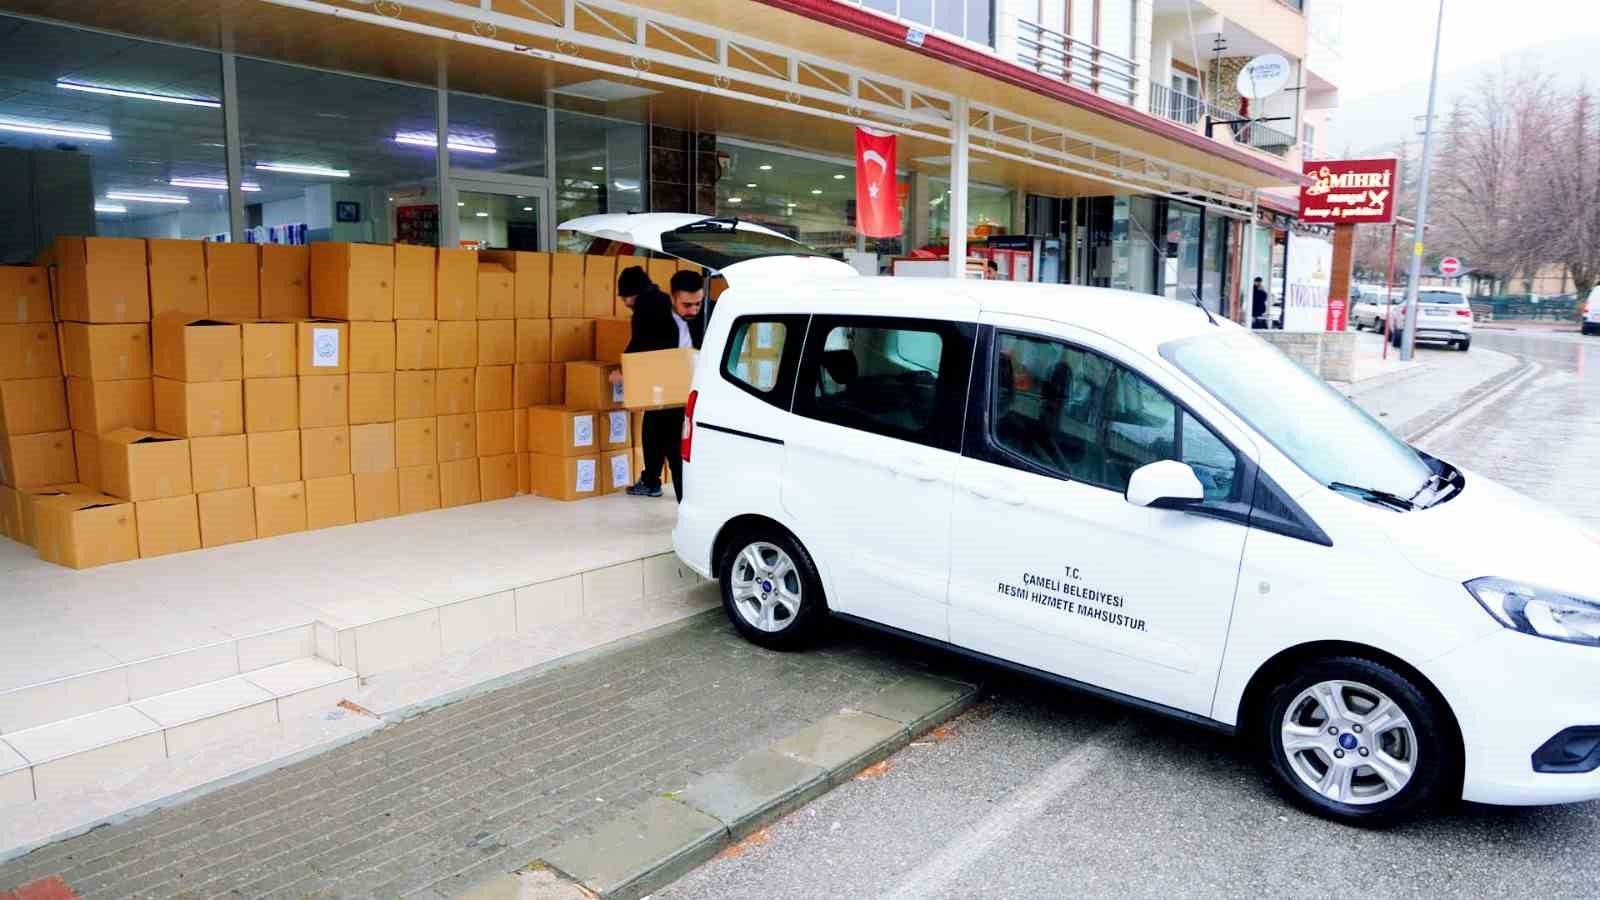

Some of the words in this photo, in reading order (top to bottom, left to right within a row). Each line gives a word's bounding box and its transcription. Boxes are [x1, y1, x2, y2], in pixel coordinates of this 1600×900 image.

[1329, 169, 1391, 187] MİHRİ
[1065, 566, 1082, 580] T.C.
[1023, 572, 1060, 592] ÇAMELİ
[1063, 583, 1123, 608] BELEDİYESİ
[998, 582, 1029, 601] RESMİ
[1031, 591, 1075, 613] HİZMETE
[1077, 604, 1148, 632] MAHSUSTUR.
